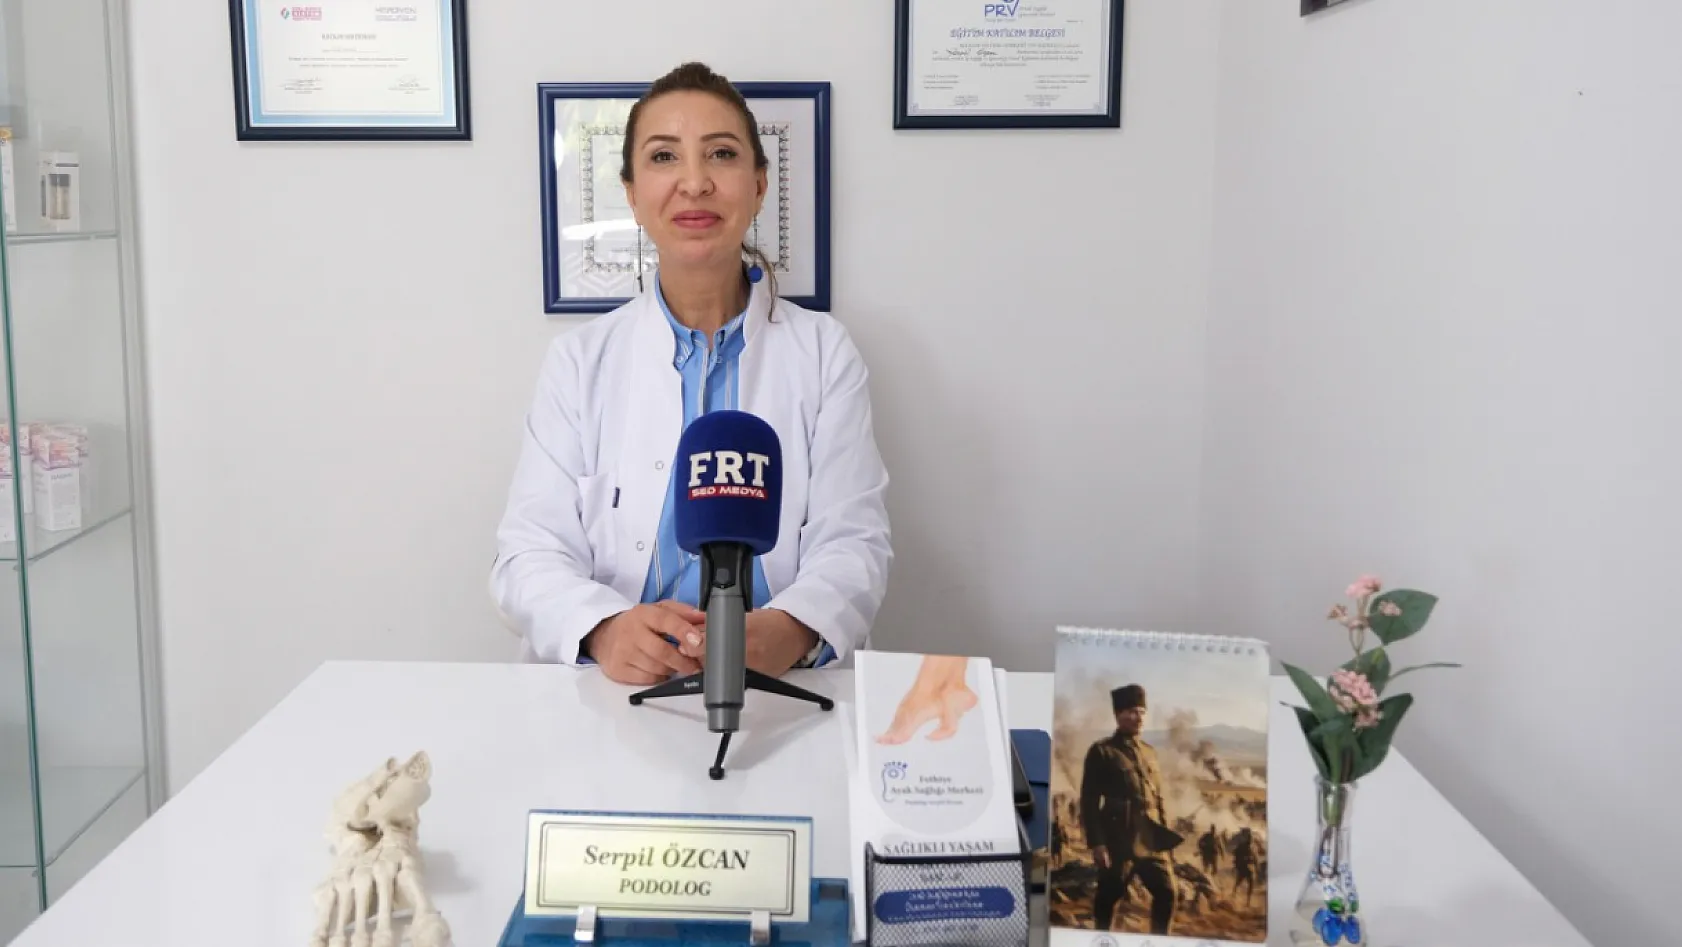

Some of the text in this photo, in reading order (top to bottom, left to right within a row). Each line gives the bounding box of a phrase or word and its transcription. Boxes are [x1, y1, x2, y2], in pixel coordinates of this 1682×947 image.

[688, 450, 770, 488] FRT
[691, 485, 765, 498] SED MEDYA
[583, 842, 750, 872] Serpil ÖZCAN
[884, 841, 995, 855] SAĞLIKLI YAŞAM
[619, 877, 712, 897] PODOLOG
